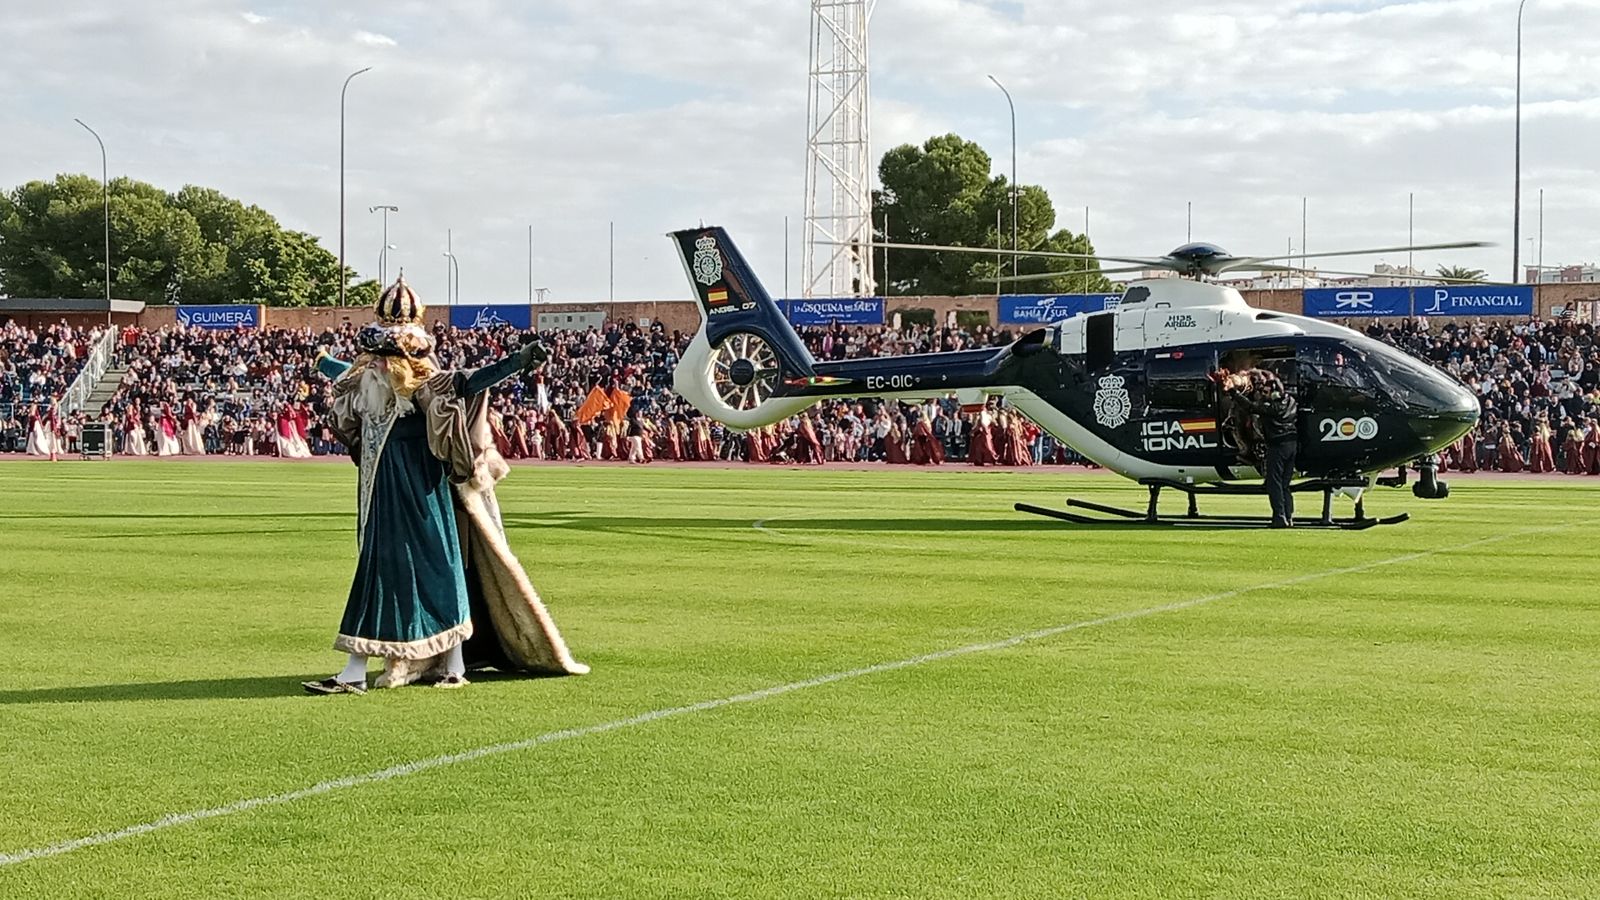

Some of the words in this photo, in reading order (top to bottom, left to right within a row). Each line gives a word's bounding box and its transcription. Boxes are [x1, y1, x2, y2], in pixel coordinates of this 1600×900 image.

[709, 304, 740, 315] ANGEL
[741, 301, 757, 310] 07
[800, 302, 844, 315] ESQUINA
[1451, 296, 1522, 307] FINANCIAL
[192, 309, 253, 323] GUIMERÁ
[1164, 320, 1197, 328] AIRBUS
[866, 374, 913, 389] EC-OIC
[1140, 420, 1184, 436] ICIA
[1319, 416, 1378, 441] 200
[1141, 434, 1218, 452] IONAL
